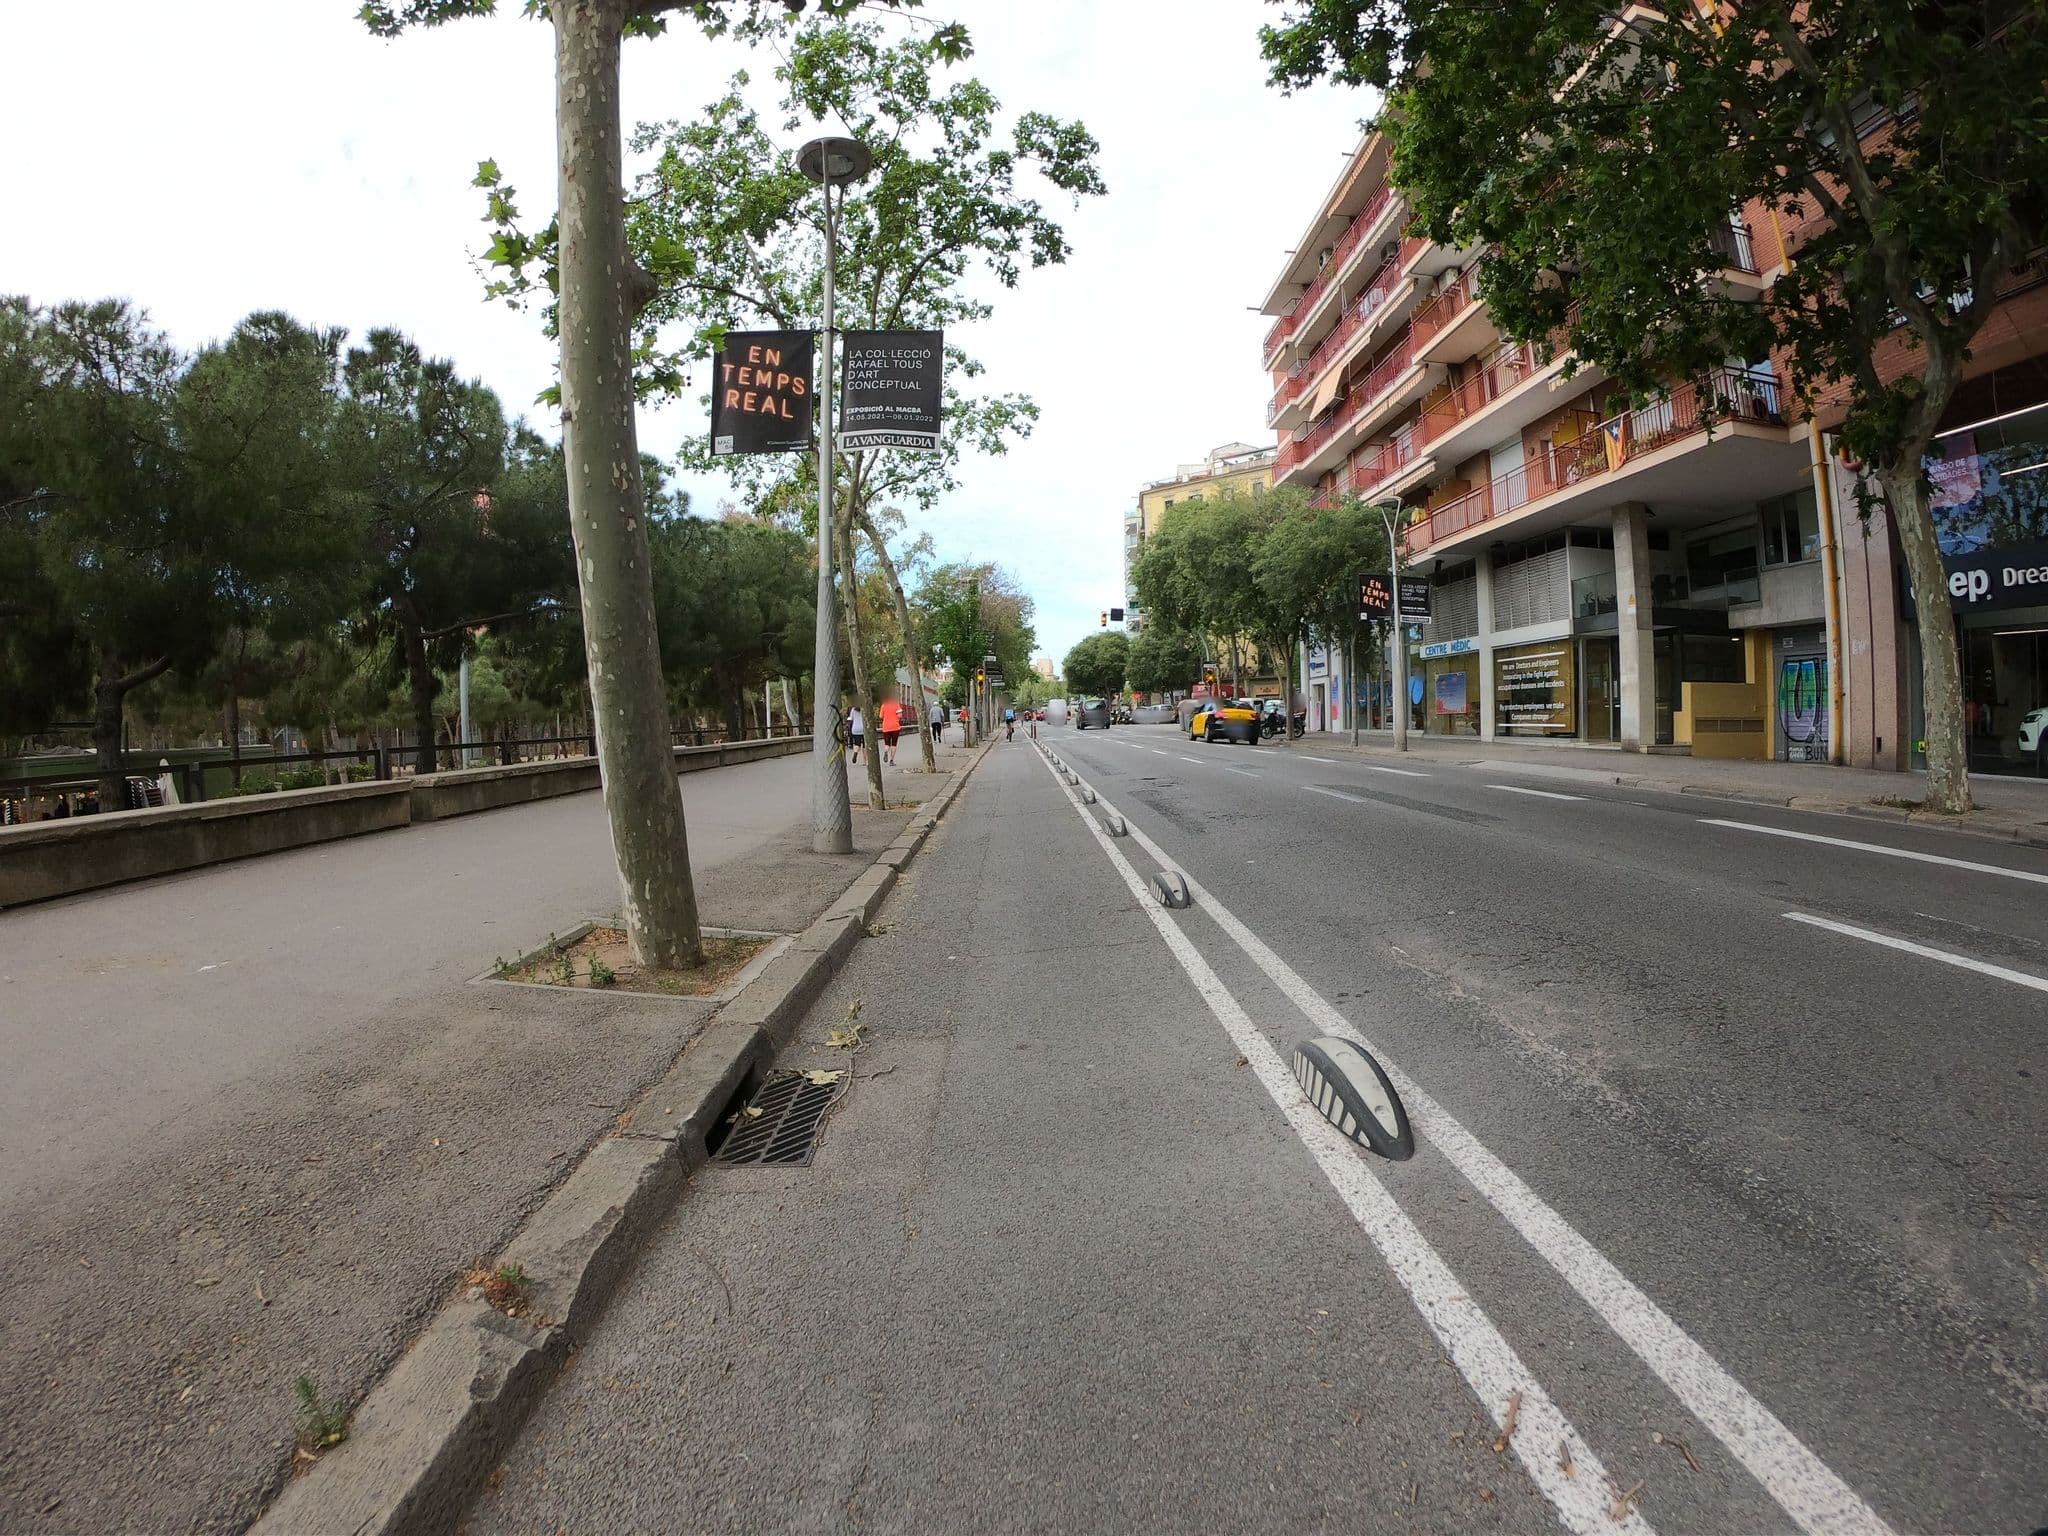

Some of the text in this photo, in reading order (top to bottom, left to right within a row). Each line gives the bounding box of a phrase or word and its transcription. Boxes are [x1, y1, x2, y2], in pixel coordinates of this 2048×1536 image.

[749, 346, 780, 367] EN
[849, 350, 863, 359] LA
[848, 360, 923, 369] RAFAEL TOUS
[722, 364, 806, 396] TEMPS
[848, 370, 880, 380] D'ART
[847, 380, 922, 390] CONCEPTUAL
[726, 389, 794, 420] REAL
[845, 435, 933, 448] LA VANGUARDIA
[1370, 579, 1381, 589] EN
[1363, 595, 1386, 609] REAL
[1425, 644, 1448, 656] CENTRE
[1533, 670, 1543, 679] fight
